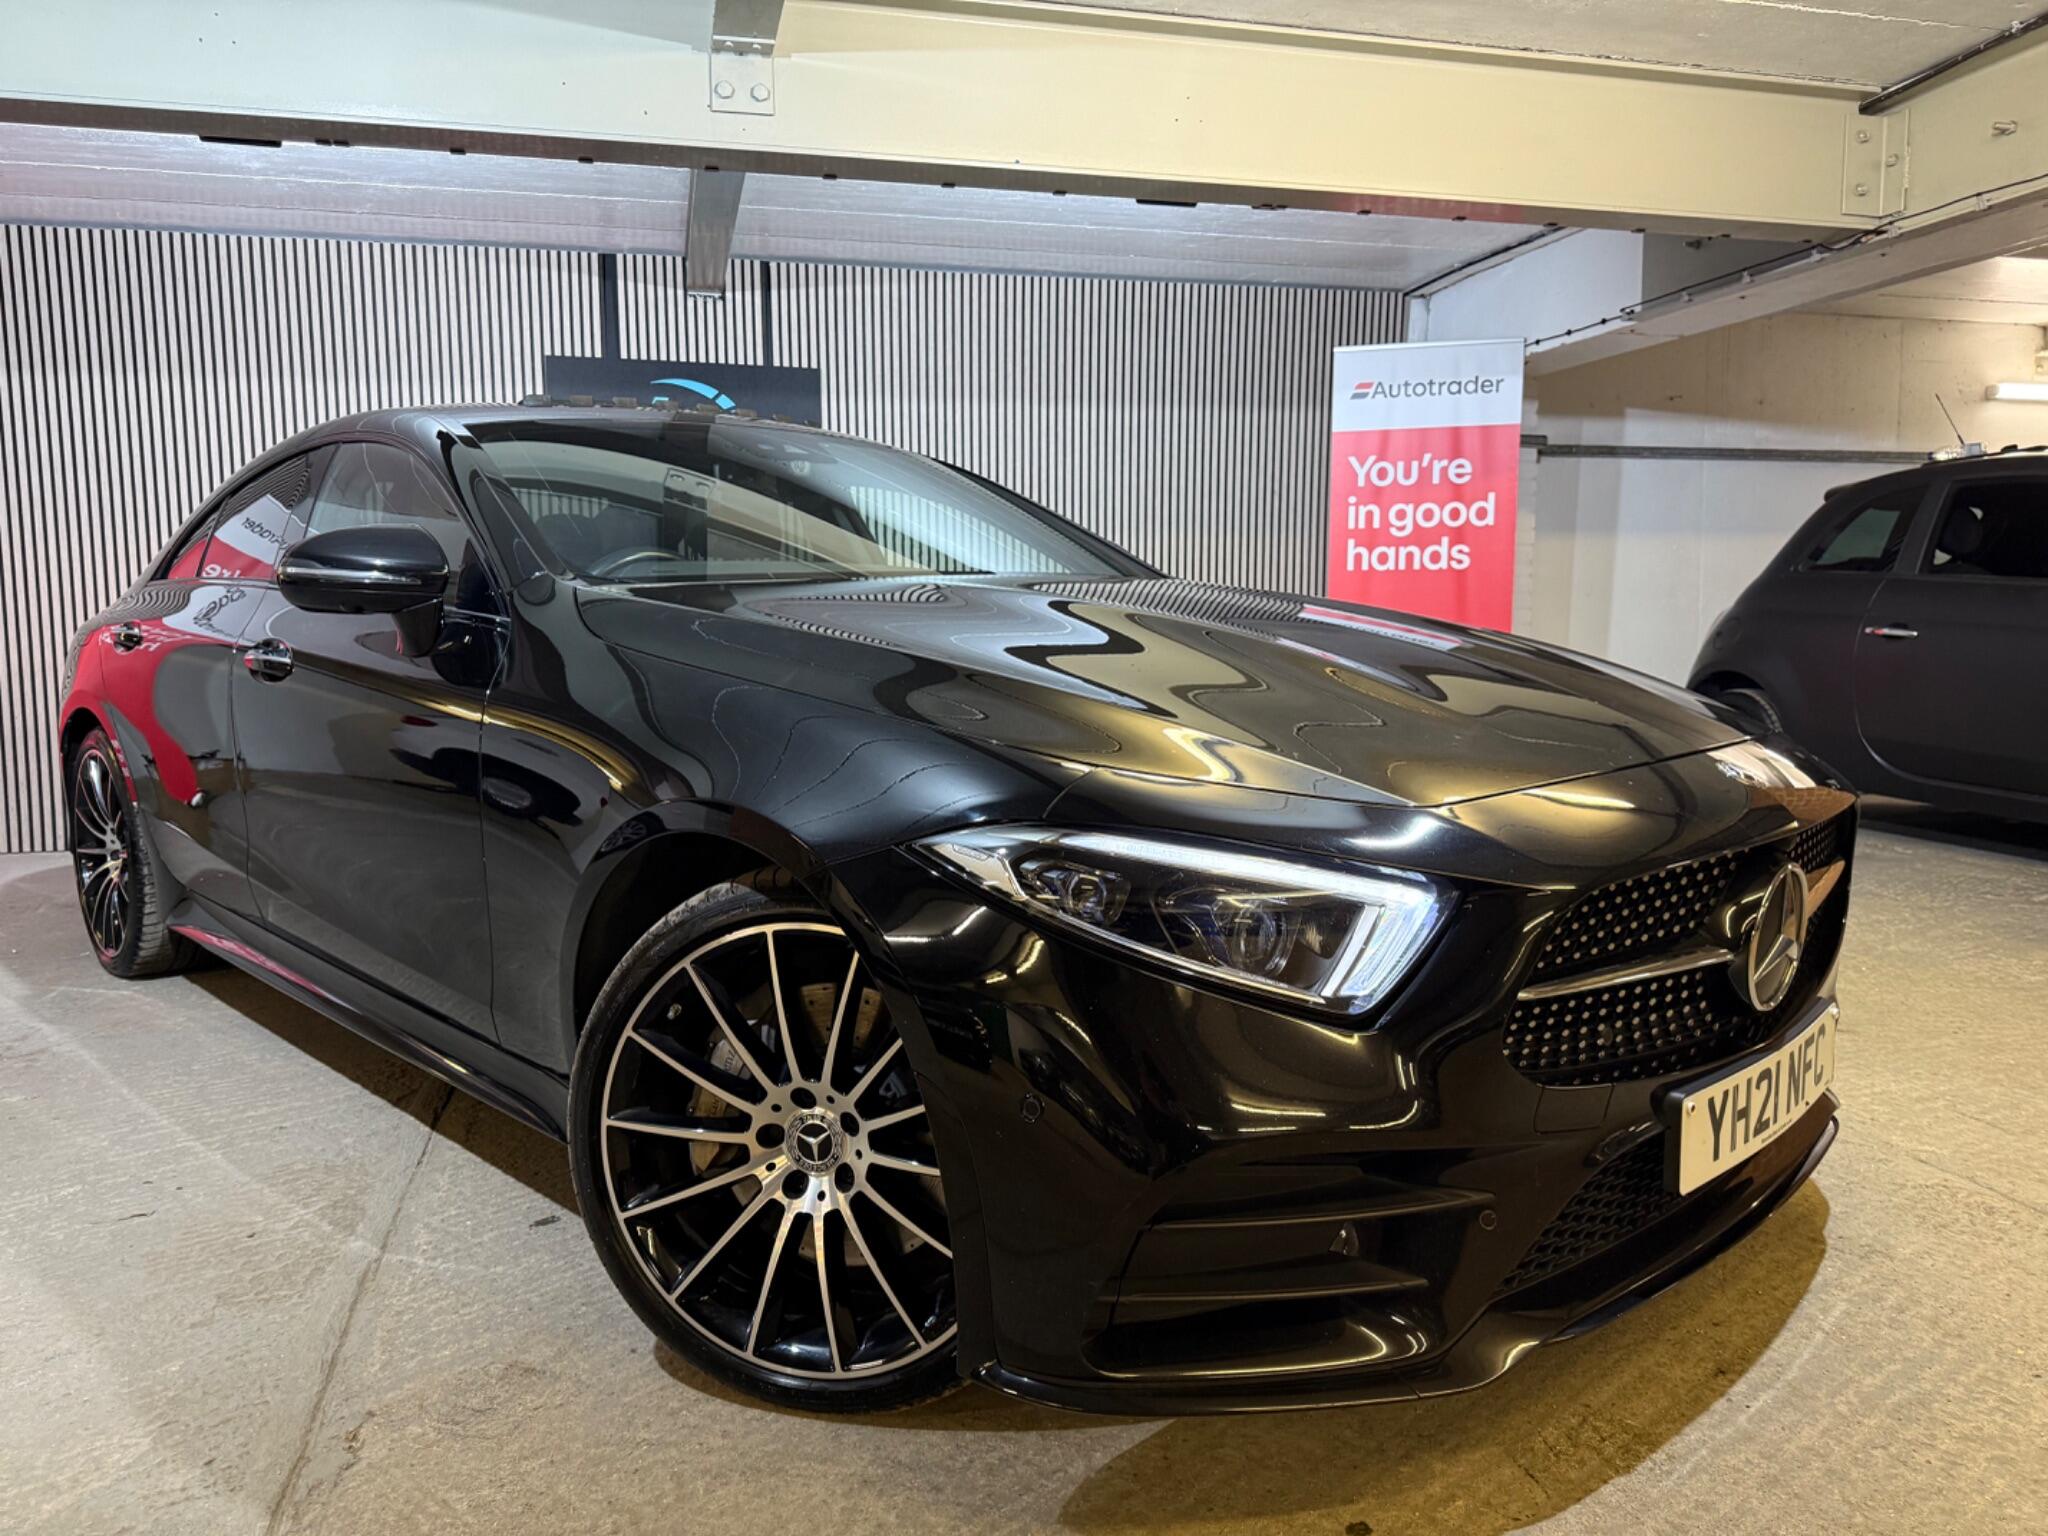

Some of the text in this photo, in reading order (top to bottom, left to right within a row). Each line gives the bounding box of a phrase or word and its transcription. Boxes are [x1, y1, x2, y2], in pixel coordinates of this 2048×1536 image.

[1371, 376, 1504, 399] Autotrader
[1348, 453, 1472, 487] You’re
[1347, 492, 1495, 537] in good
[1347, 536, 1471, 571] hands
[1708, 1023, 1826, 1162] YH21 NFC
